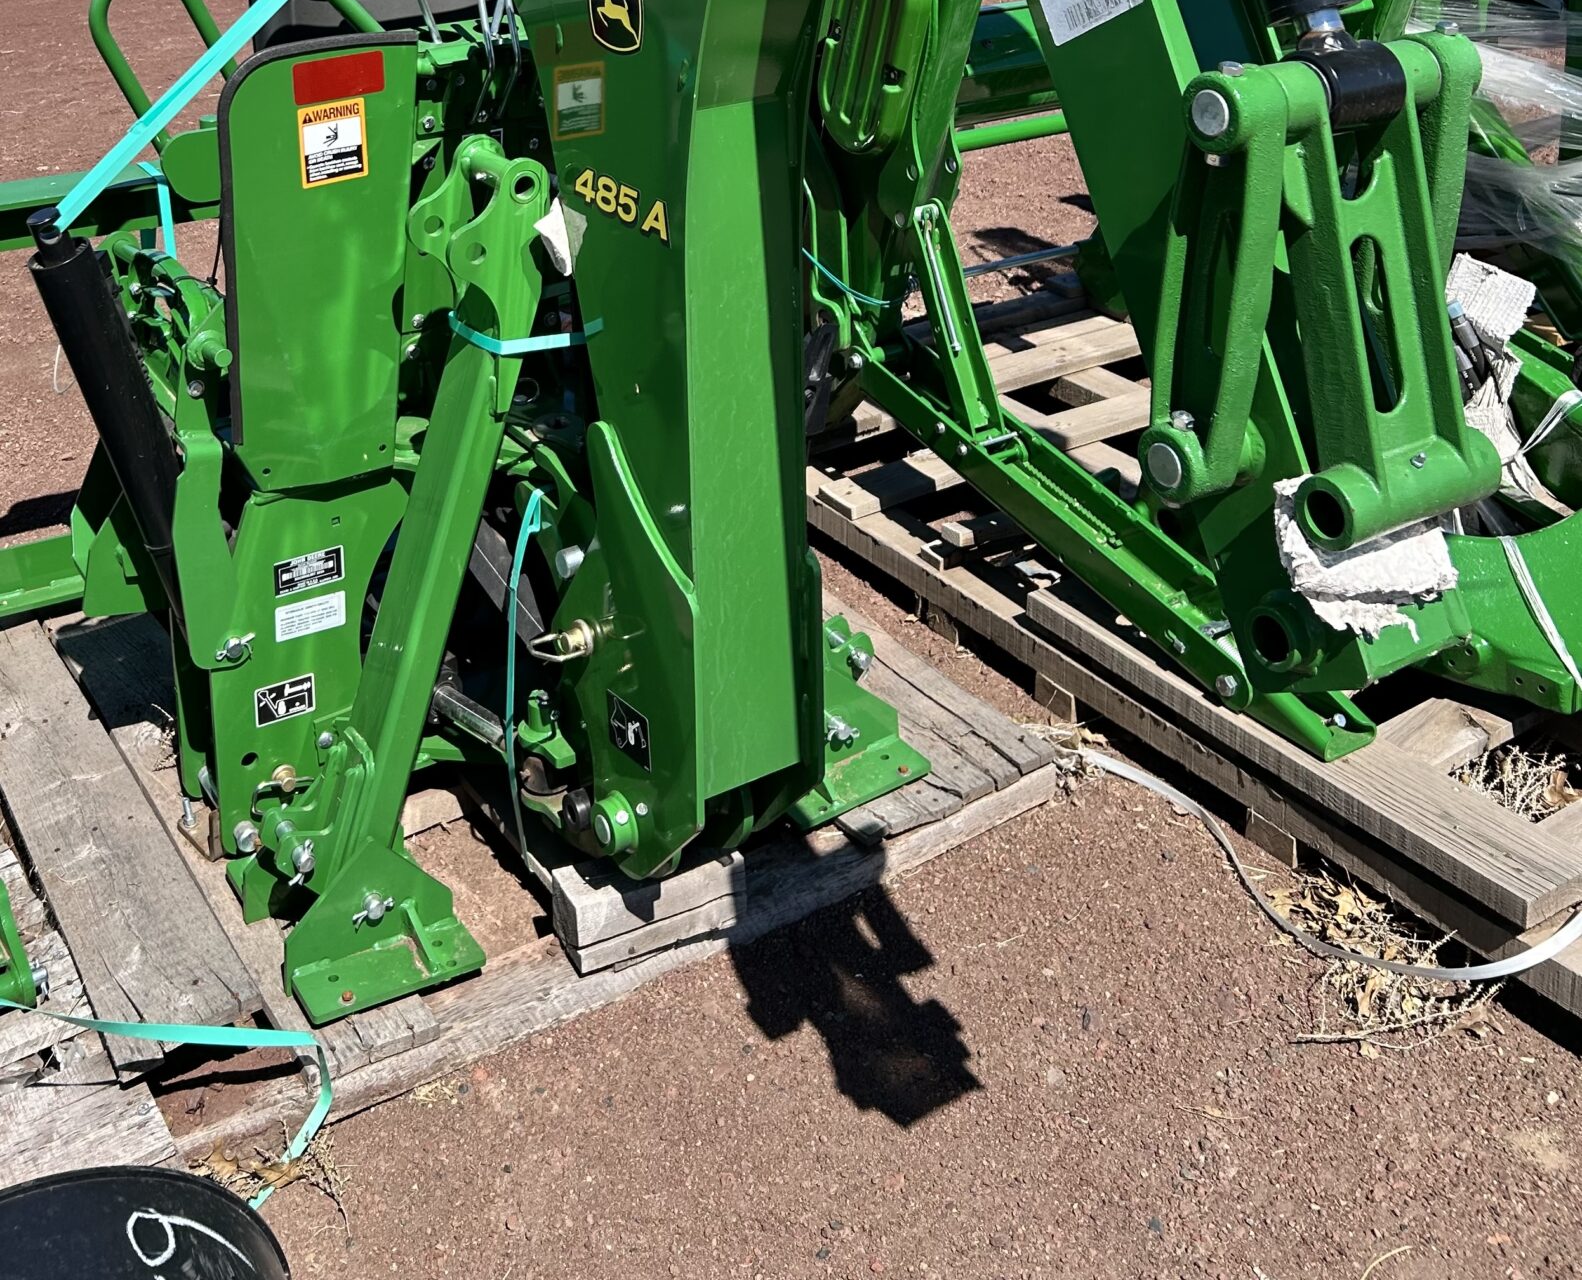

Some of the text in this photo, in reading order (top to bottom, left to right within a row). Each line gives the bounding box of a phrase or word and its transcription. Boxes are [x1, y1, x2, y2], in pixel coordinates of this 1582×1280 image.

[312, 102, 360, 122] WARNING
[575, 169, 668, 241] 485 A
[290, 551, 326, 567] JOHN DEERE
